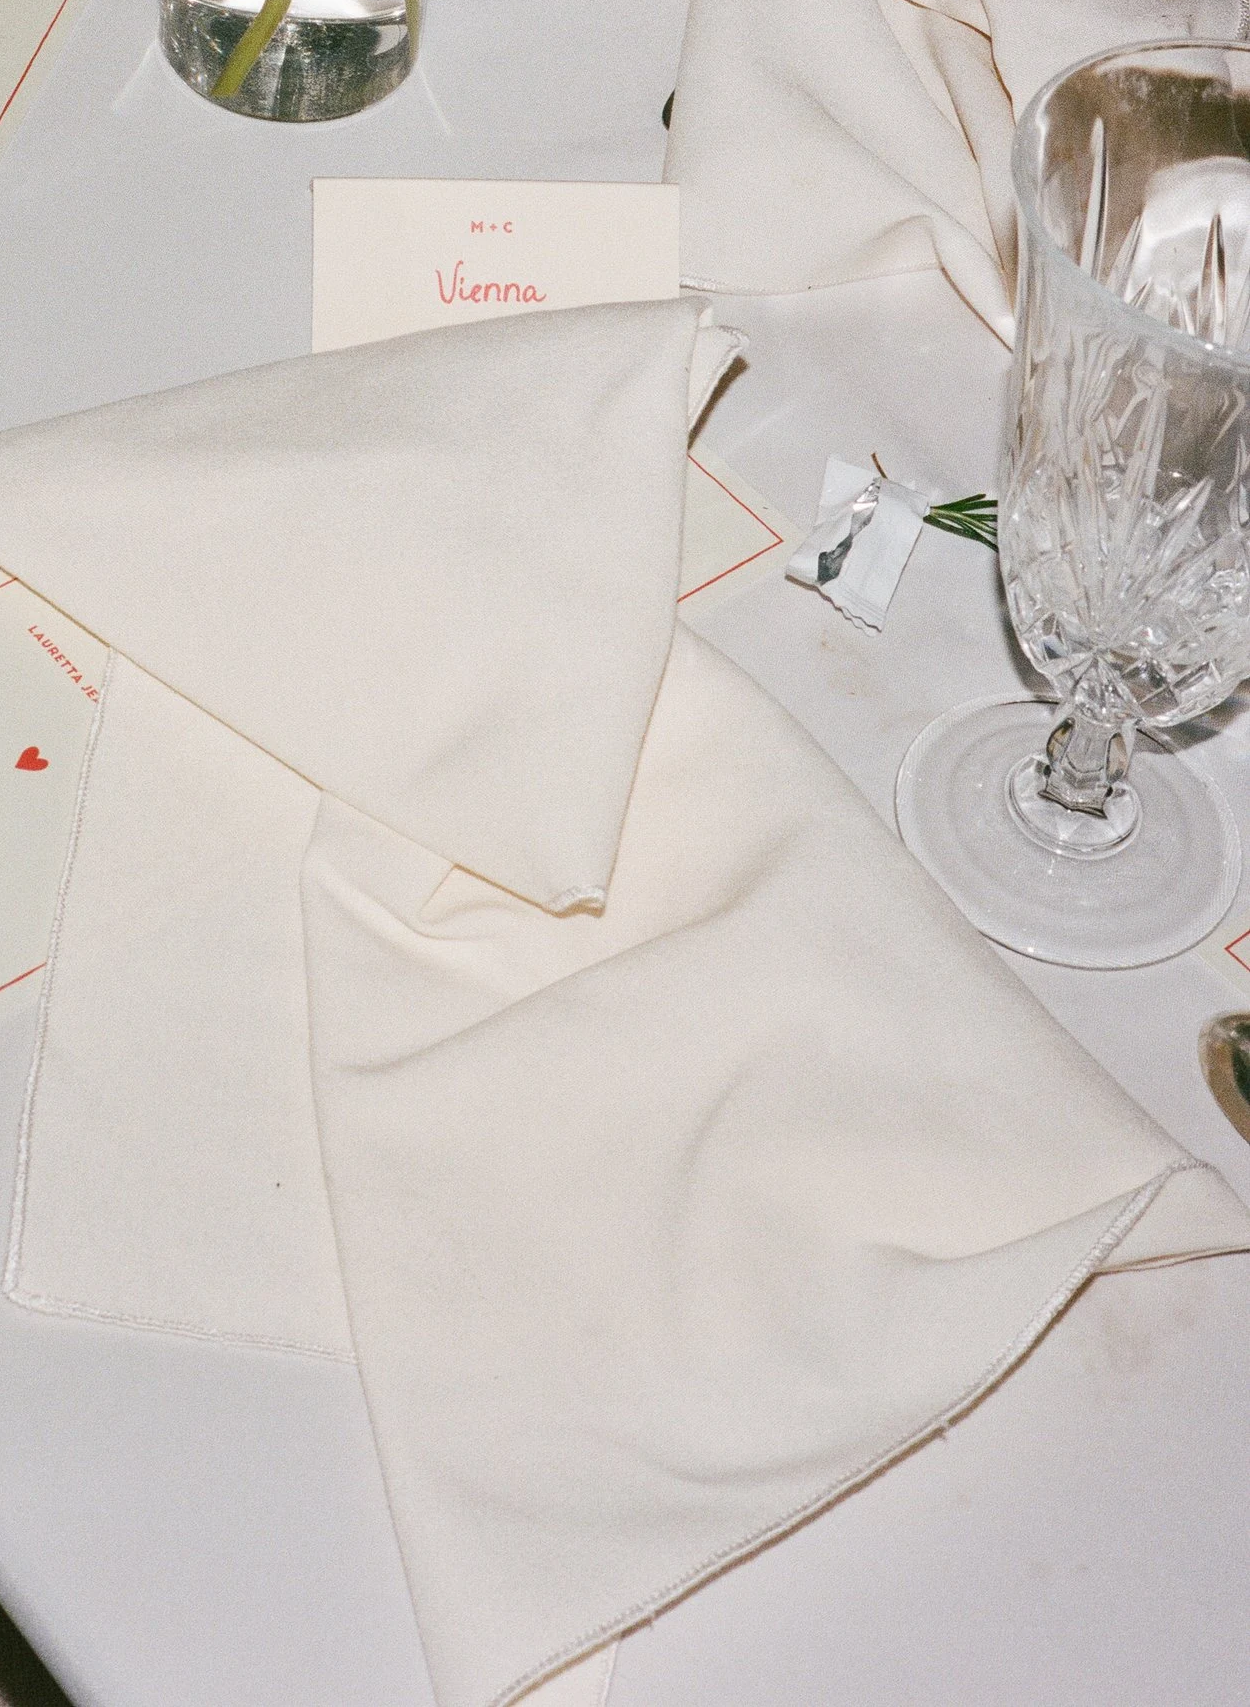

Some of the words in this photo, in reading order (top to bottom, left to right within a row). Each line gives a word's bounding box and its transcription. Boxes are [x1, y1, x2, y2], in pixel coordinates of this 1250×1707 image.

[470, 220, 483, 233] M
[489, 223, 498, 232] +
[502, 221, 512, 234] C
[435, 259, 548, 305] Vienna
[28, 625, 83, 684] LAURETTA
